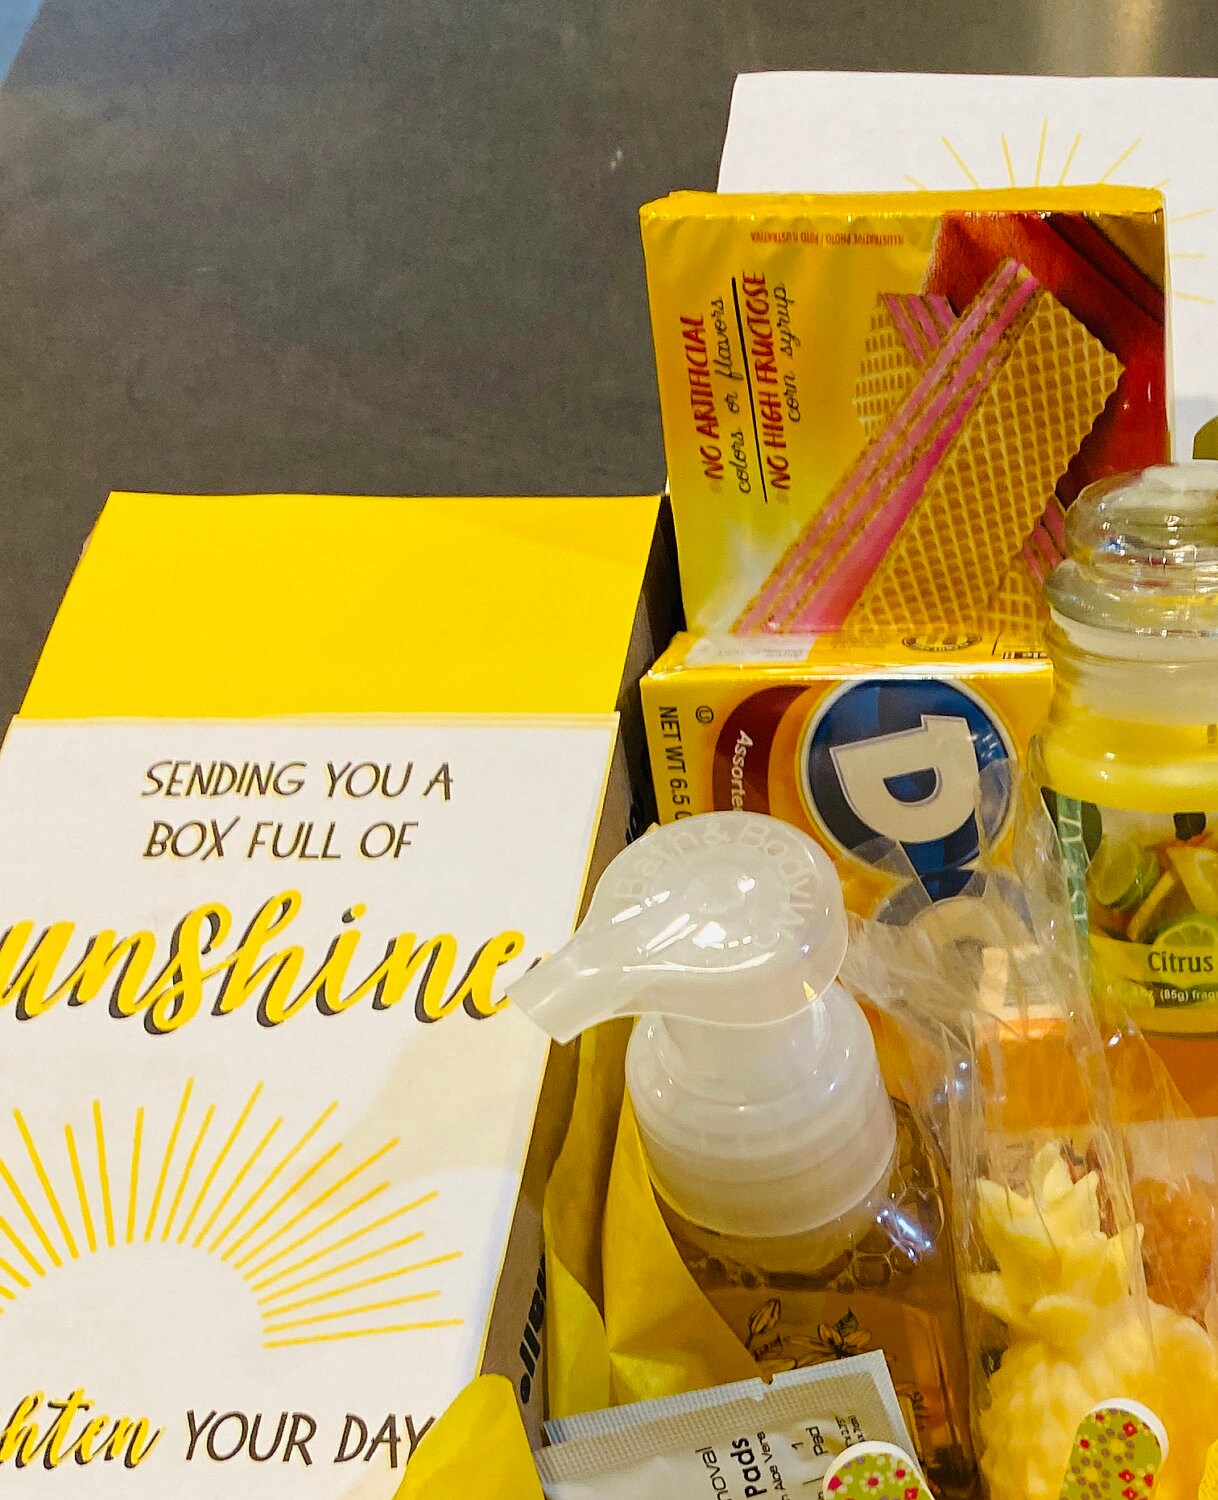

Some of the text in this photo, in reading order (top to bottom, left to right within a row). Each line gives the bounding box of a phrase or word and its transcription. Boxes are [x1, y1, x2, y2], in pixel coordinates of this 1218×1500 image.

[773, 281, 801, 423] corn syrup
[679, 313, 724, 480] NO ARTIFICIAL
[710, 296, 751, 494] colors or flavors
[742, 270, 791, 490] NO HIGH FRUCTOSE
[658, 705, 682, 742] NET
[141, 759, 455, 802] SENDING YOU A
[665, 745, 687, 774] WT
[730, 729, 754, 812] Assorte
[669, 777, 691, 806] 6.5
[142, 817, 419, 861] BOX FULL OF
[0, 888, 550, 1036] unshine
[1147, 950, 1215, 974] Citrus
[0, 1387, 437, 1470] hten YOUR DAY
[756, 1431, 773, 1463] Vera
[805, 1425, 829, 1457] Pad
[730, 1437, 768, 1499] Pads
[769, 1464, 786, 1491] Aloe
